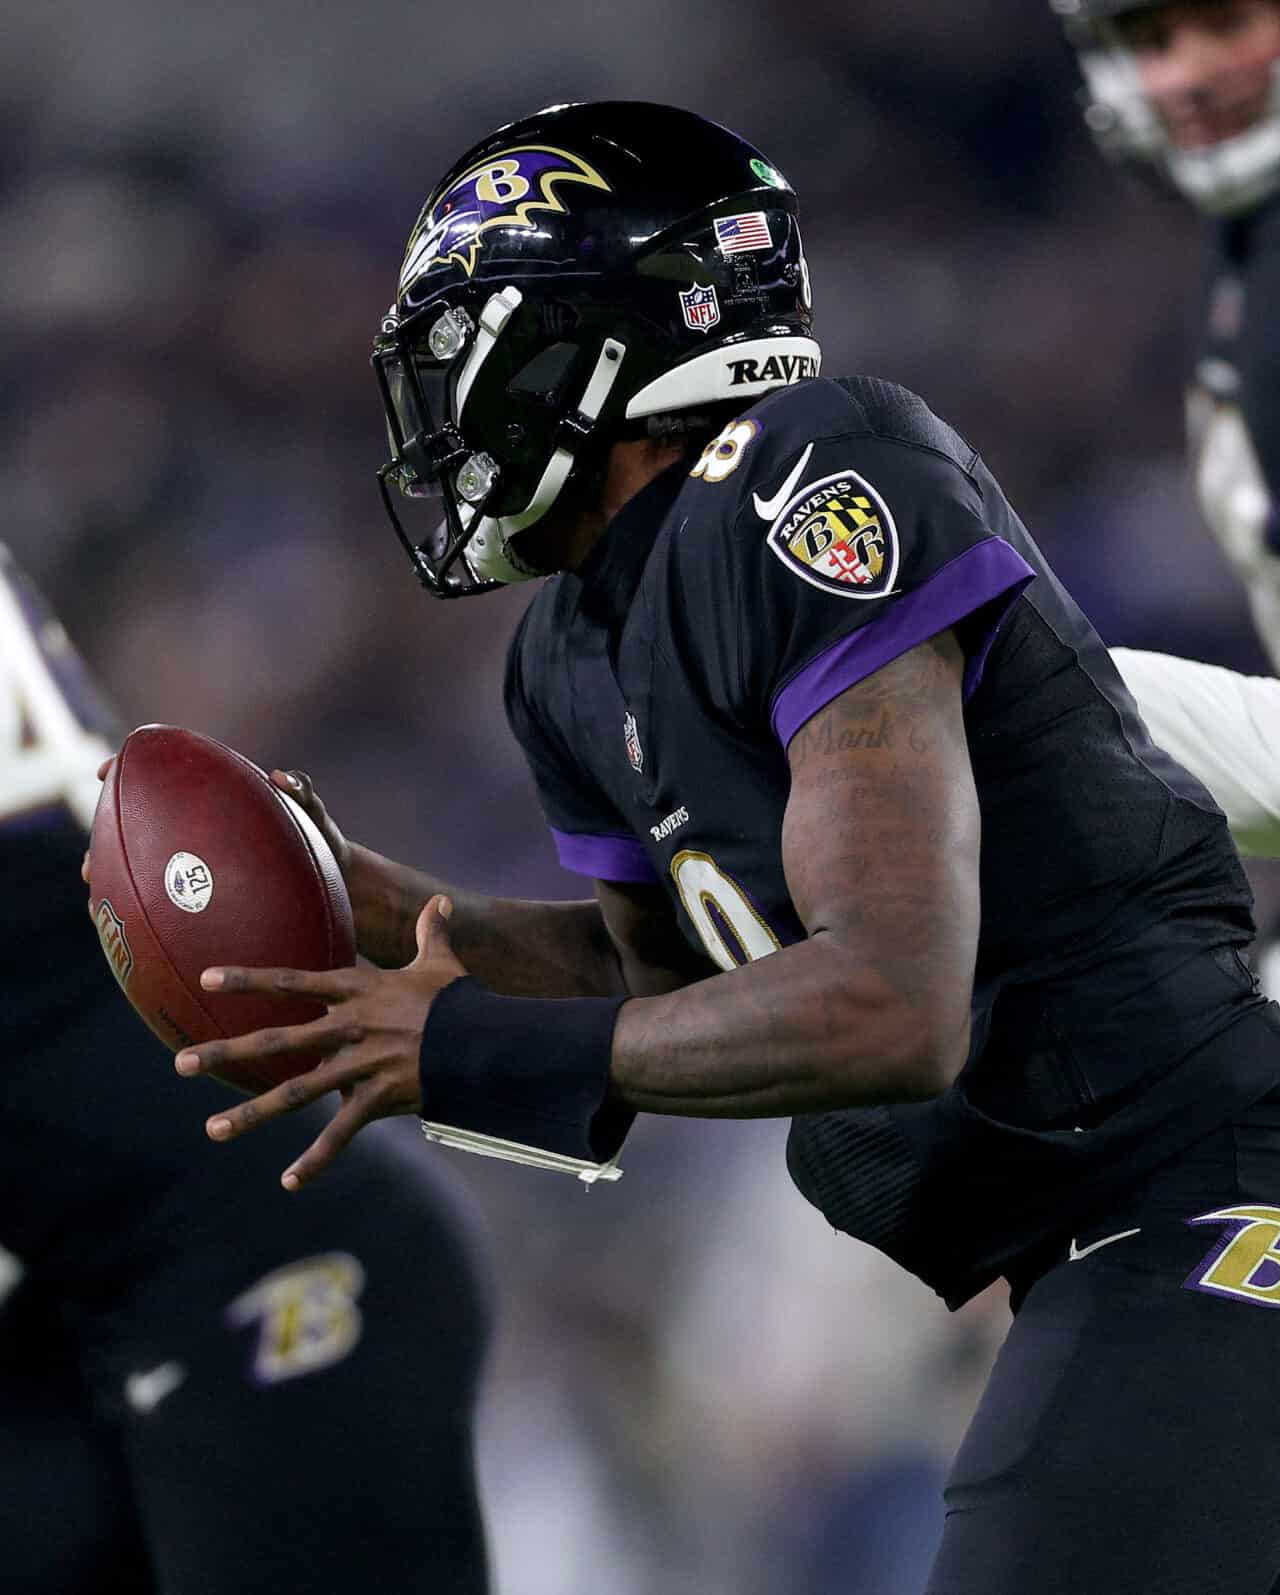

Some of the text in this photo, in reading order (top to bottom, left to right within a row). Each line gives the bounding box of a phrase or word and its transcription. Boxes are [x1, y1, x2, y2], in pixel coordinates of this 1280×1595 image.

[458, 159, 530, 204] B
[688, 303, 715, 325] NFL
[780, 481, 851, 540] RAVENS
[649, 806, 689, 841] RAVENS
[185, 865, 210, 894] 125
